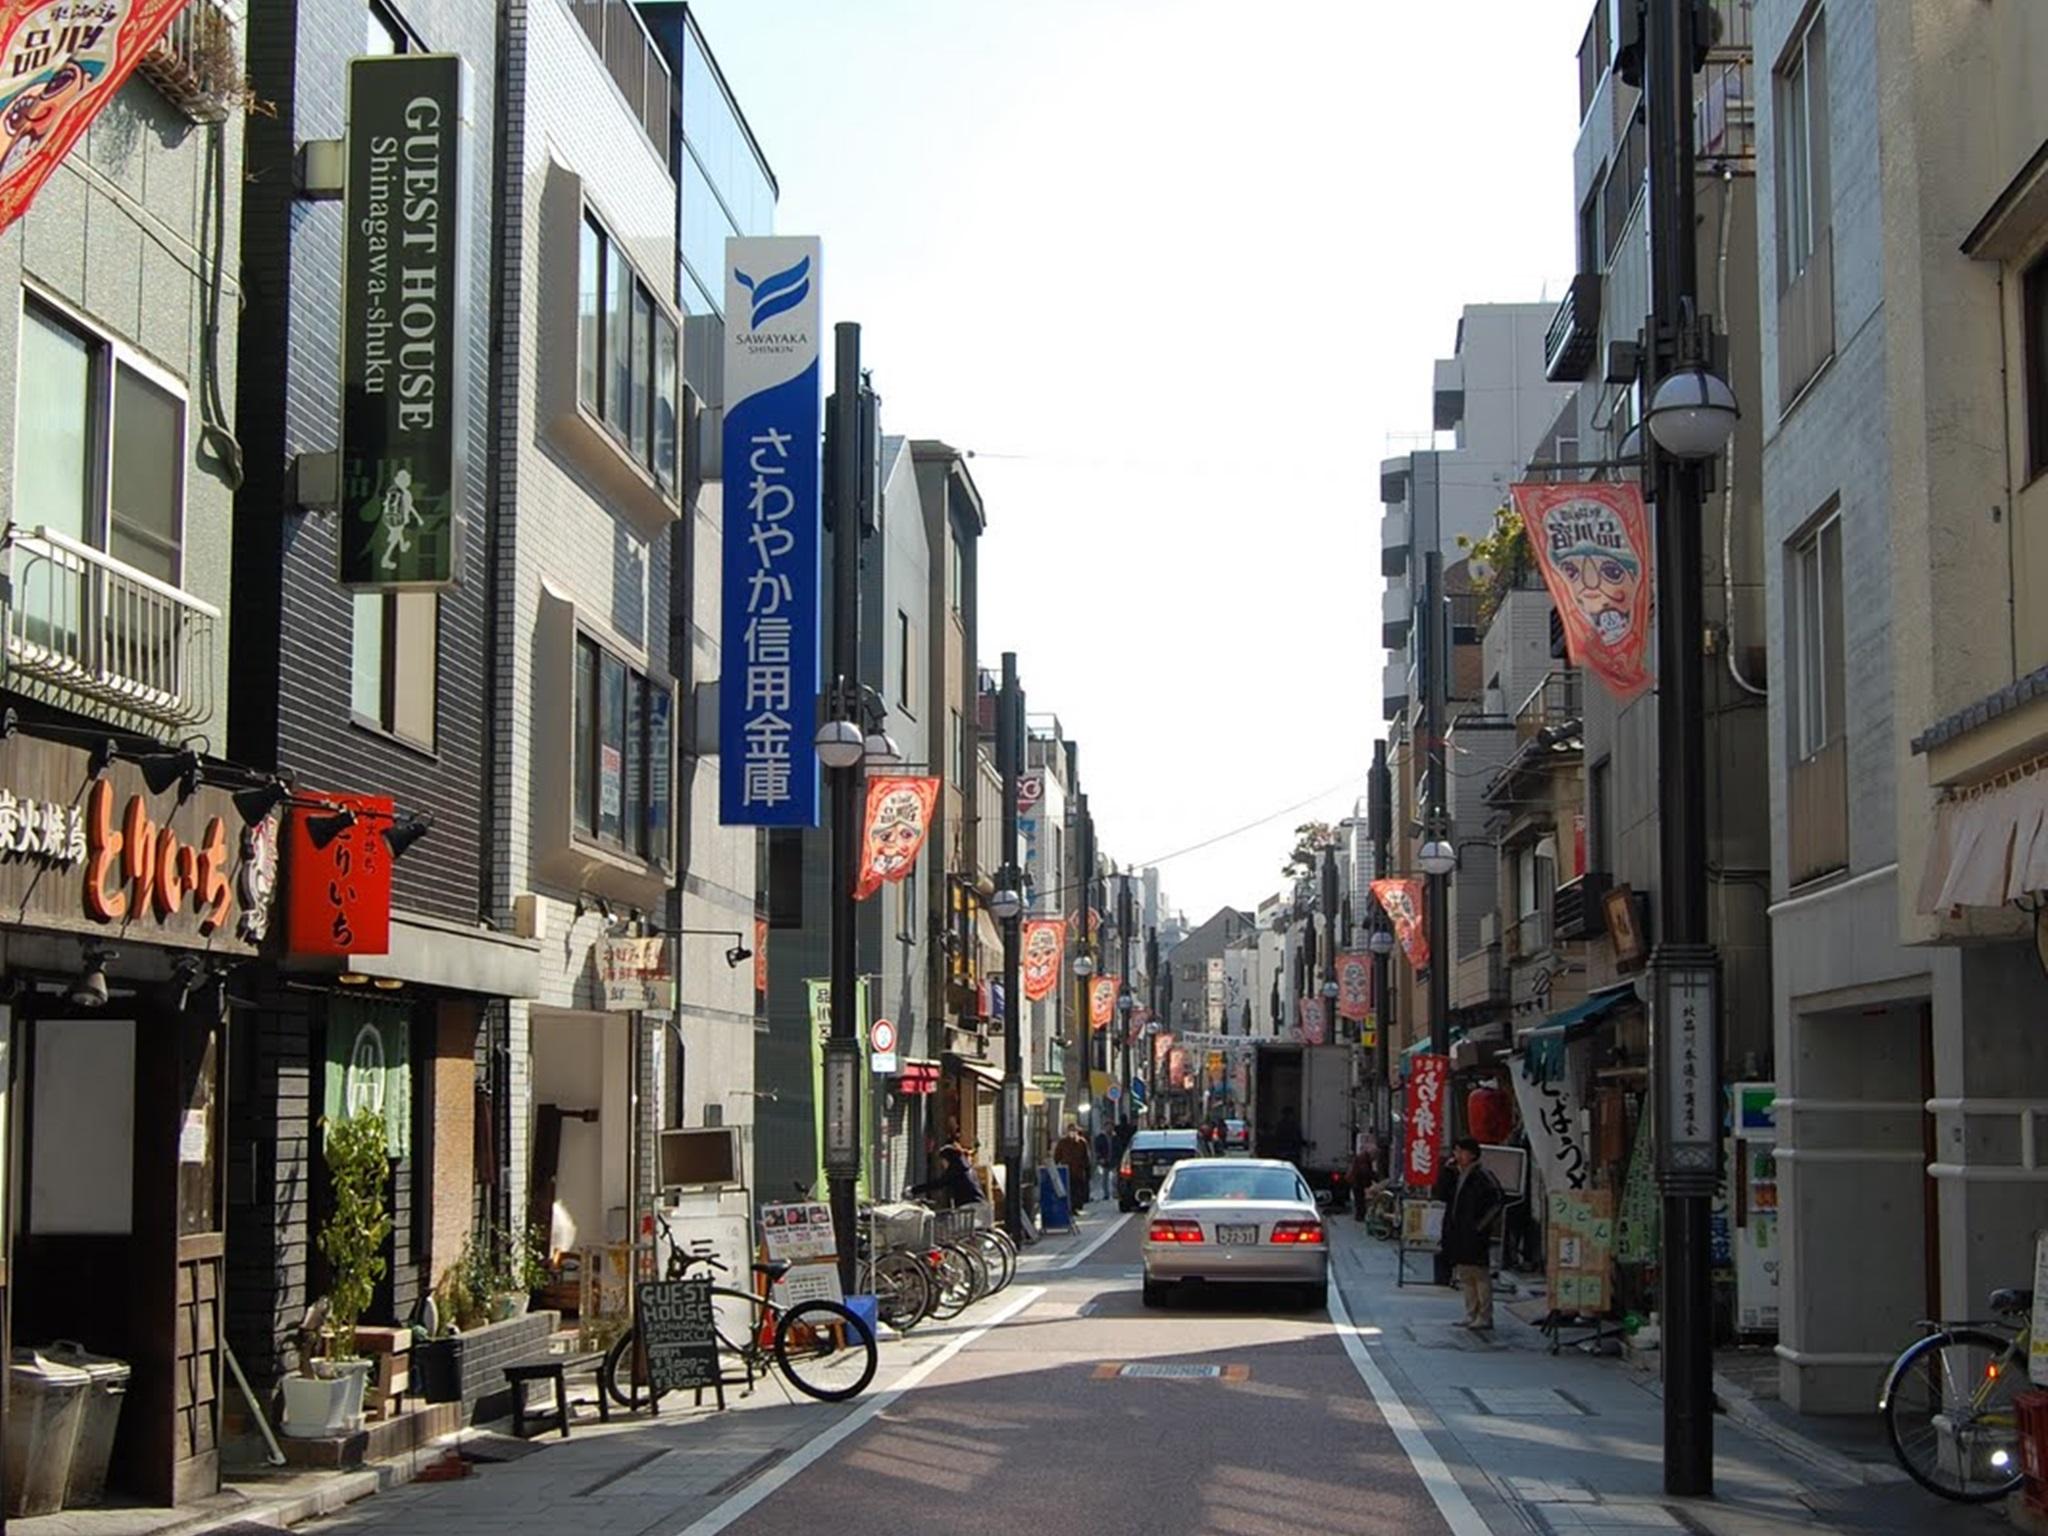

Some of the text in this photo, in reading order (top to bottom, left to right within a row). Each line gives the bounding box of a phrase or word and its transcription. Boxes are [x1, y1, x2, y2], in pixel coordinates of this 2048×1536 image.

[362, 136, 398, 394] Shinagawa-shuku
[397, 96, 441, 431] GUEST HOUSE
[736, 333, 808, 345] SAWAYAKA
[748, 346, 794, 355] SHINKIN
[743, 427, 794, 808] さわやか信用金庫
[87, 778, 232, 935] とりいち
[641, 1284, 708, 1304] GUEST
[642, 1304, 710, 1321] HOUSE
